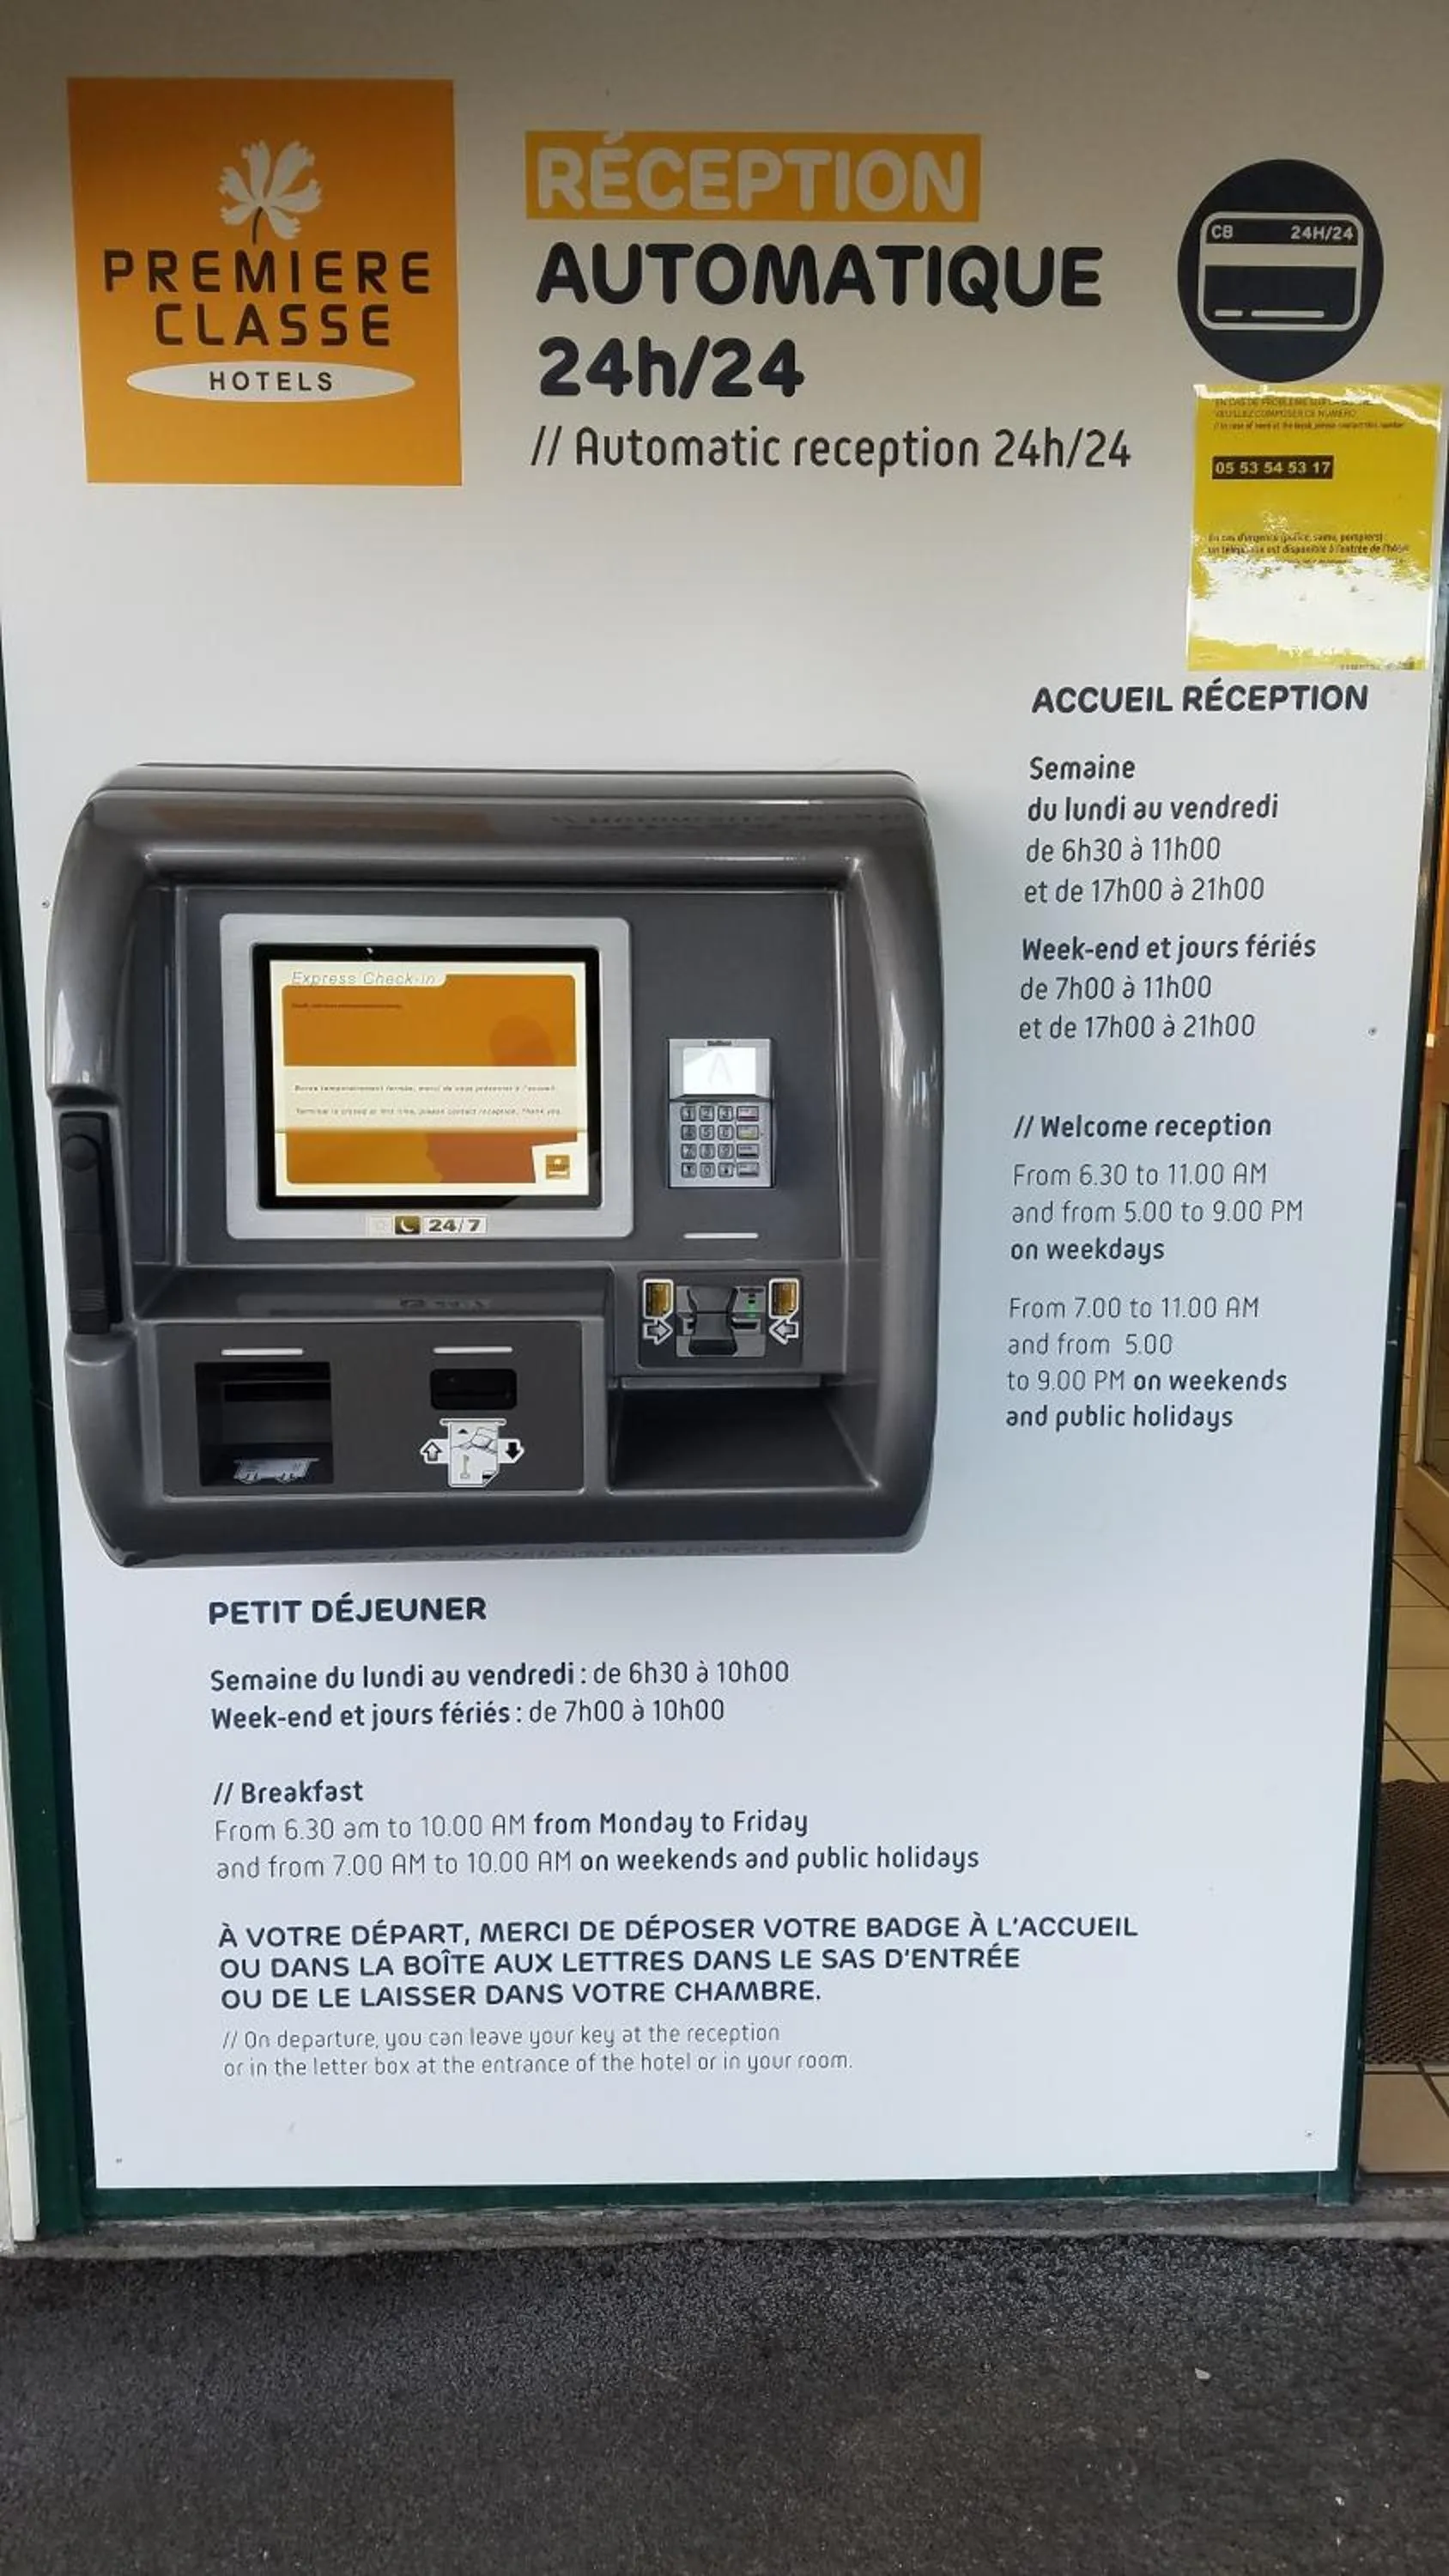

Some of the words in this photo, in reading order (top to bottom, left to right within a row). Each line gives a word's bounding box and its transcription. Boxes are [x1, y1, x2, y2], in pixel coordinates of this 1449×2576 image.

[536, 130, 965, 213] RÉCEPTION
[1210, 224, 1234, 239] CB
[1290, 224, 1355, 240] 24H/24
[104, 249, 430, 295] PREMIERE
[535, 241, 1103, 314] AUTOMATIQUE
[155, 302, 390, 348] CLASSE
[209, 371, 332, 392] HOTELS
[538, 335, 806, 400] 24h/24
[576, 425, 780, 467] Automatic
[794, 425, 979, 477] reception
[994, 426, 1132, 469] 24h/24
[1215, 461, 1234, 475] 05
[1240, 461, 1258, 475] 53
[1263, 461, 1284, 475] 54
[1288, 461, 1307, 475] 53
[1313, 461, 1331, 474] 17
[1031, 686, 1173, 714] ACCUEIL
[1182, 677, 1368, 712] RÉCEPTION
[1029, 753, 1136, 781] Semaine
[1028, 796, 1058, 822] du
[1065, 794, 1126, 822] lundi
[1132, 801, 1163, 821] au
[1170, 793, 1278, 820] vendredi
[1026, 837, 1055, 863] de
[1062, 837, 1122, 863] 6h30
[1130, 835, 1143, 861] à
[1152, 835, 1221, 861] 11h00
[1024, 880, 1048, 904] et
[1055, 878, 1083, 903] de
[1091, 877, 1163, 902] 17h00
[1170, 876, 1184, 902] à
[1191, 875, 1264, 902] 21h00
[1022, 935, 1139, 961] Week-end
[1146, 937, 1172, 960] et
[1175, 934, 1239, 966] jours
[1245, 932, 1316, 958] fériés
[291, 970, 357, 987] Express
[363, 970, 436, 985] Check-in
[1040, 1114, 1148, 1138] Welcome
[1155, 1112, 1271, 1143] reception
[1014, 1163, 1070, 1187] From
[1079, 1163, 1127, 1186] 6.30
[1137, 1163, 1159, 1186] to
[1167, 1162, 1225, 1186] 11.00
[1233, 1162, 1267, 1185] AM
[428, 1218, 482, 1233] 24/7
[1012, 1200, 1053, 1224] and
[1061, 1200, 1115, 1224] from
[1124, 1200, 1172, 1224] 5.00
[1180, 1201, 1204, 1224] to
[1213, 1200, 1263, 1223] 9.00
[1271, 1200, 1303, 1222] PM
[1010, 1242, 1038, 1261] on
[1046, 1236, 1165, 1267] weekdays
[1009, 1297, 1065, 1320] From
[1074, 1296, 1121, 1319] 7.00
[1129, 1297, 1152, 1319] to
[1161, 1296, 1217, 1319] 11.00
[1225, 1296, 1259, 1318] AM
[1007, 1332, 1049, 1356] and
[1057, 1332, 1110, 1356] from
[1125, 1333, 1173, 1356] 5.00
[1007, 1370, 1029, 1391] to
[1038, 1370, 1086, 1392] 9.00
[1094, 1370, 1125, 1391] PM
[1133, 1374, 1161, 1391] on
[1168, 1368, 1287, 1391] weekends
[1005, 1404, 1048, 1427] and
[1055, 1404, 1126, 1433] public
[1133, 1404, 1234, 1433] holidays
[209, 1600, 303, 1625] PETIT
[312, 1593, 487, 1624] DÉJEUNER
[210, 1667, 318, 1692] Semaine
[325, 1665, 355, 1689] du
[363, 1663, 423, 1689] lundi
[431, 1669, 460, 1687] au
[467, 1662, 574, 1686] vendredi
[593, 1661, 621, 1685] de
[629, 1660, 688, 1684] 6h30
[696, 1660, 708, 1684] à
[717, 1659, 789, 1684] 10h00
[241, 1778, 364, 1804] Breakfast
[215, 1820, 276, 1842] From
[285, 1818, 334, 1840] 6.30
[343, 1821, 379, 1840] am
[387, 1818, 411, 1838] to
[421, 1814, 482, 1837] 10.00
[492, 1814, 524, 1836] AM
[533, 1811, 591, 1835] from
[600, 1810, 694, 1839] Monday
[700, 1811, 725, 1832] to
[733, 1808, 808, 1838] Friday
[218, 1922, 238, 1948] À
[246, 1925, 342, 1948] VOTRE
[351, 1918, 470, 1947] DÉPART,
[480, 1921, 569, 1943] MERCI
[579, 1920, 615, 1941] DE
[625, 1915, 755, 1941] DÉPOSER
[763, 1917, 857, 1939] VOTRE
[866, 1916, 960, 1938] BADGE
[968, 1911, 988, 1937] À
[997, 1916, 1139, 1938] L'ACCUEIL
[220, 1958, 260, 1979] OU
[270, 1956, 349, 1978] DANS
[360, 1955, 394, 1977] LA
[403, 1948, 485, 1976] BOÎTE
[494, 1952, 553, 1974] AUX
[562, 1950, 684, 1972] LETTRES
[694, 1949, 772, 1971] DANS
[780, 1948, 812, 1970] LE
[822, 1948, 876, 1970] SAS
[885, 1941, 1021, 1969] D'ENTRÉE
[221, 1989, 262, 2010] OU
[272, 1988, 308, 2008] DE
[318, 1987, 351, 2008] LE
[361, 1984, 476, 2008] LAISSER
[485, 1983, 564, 2005] DANS
[572, 1981, 665, 2004] VOTRE
[675, 1979, 821, 2002] CHAMBRE.
[245, 2030, 270, 2050] On
[277, 2029, 379, 2053] departure,
[385, 2032, 422, 2052] you
[428, 2031, 463, 2046] can
[470, 2027, 523, 2046] leave
[530, 2029, 575, 2050] your
[581, 2024, 615, 2049] key
[622, 2026, 642, 2044] at
[648, 2023, 681, 2043] the
[687, 2021, 779, 2046] reception
[224, 2062, 244, 2077] or
[250, 2057, 267, 2077] in
[274, 2057, 306, 2077] the
[313, 2057, 368, 2075] letter
[374, 2057, 409, 2075] box
[416, 2057, 437, 2075] at
[442, 2056, 475, 2075] the
[482, 2056, 569, 2074] entrance
[576, 2052, 597, 2072] of
[602, 2052, 634, 2072] the
[640, 2052, 691, 2072] hotel
[697, 2056, 717, 2070] or
[724, 2055, 741, 2070] in
[747, 2055, 792, 2075] your
[797, 2054, 852, 2069] room.
